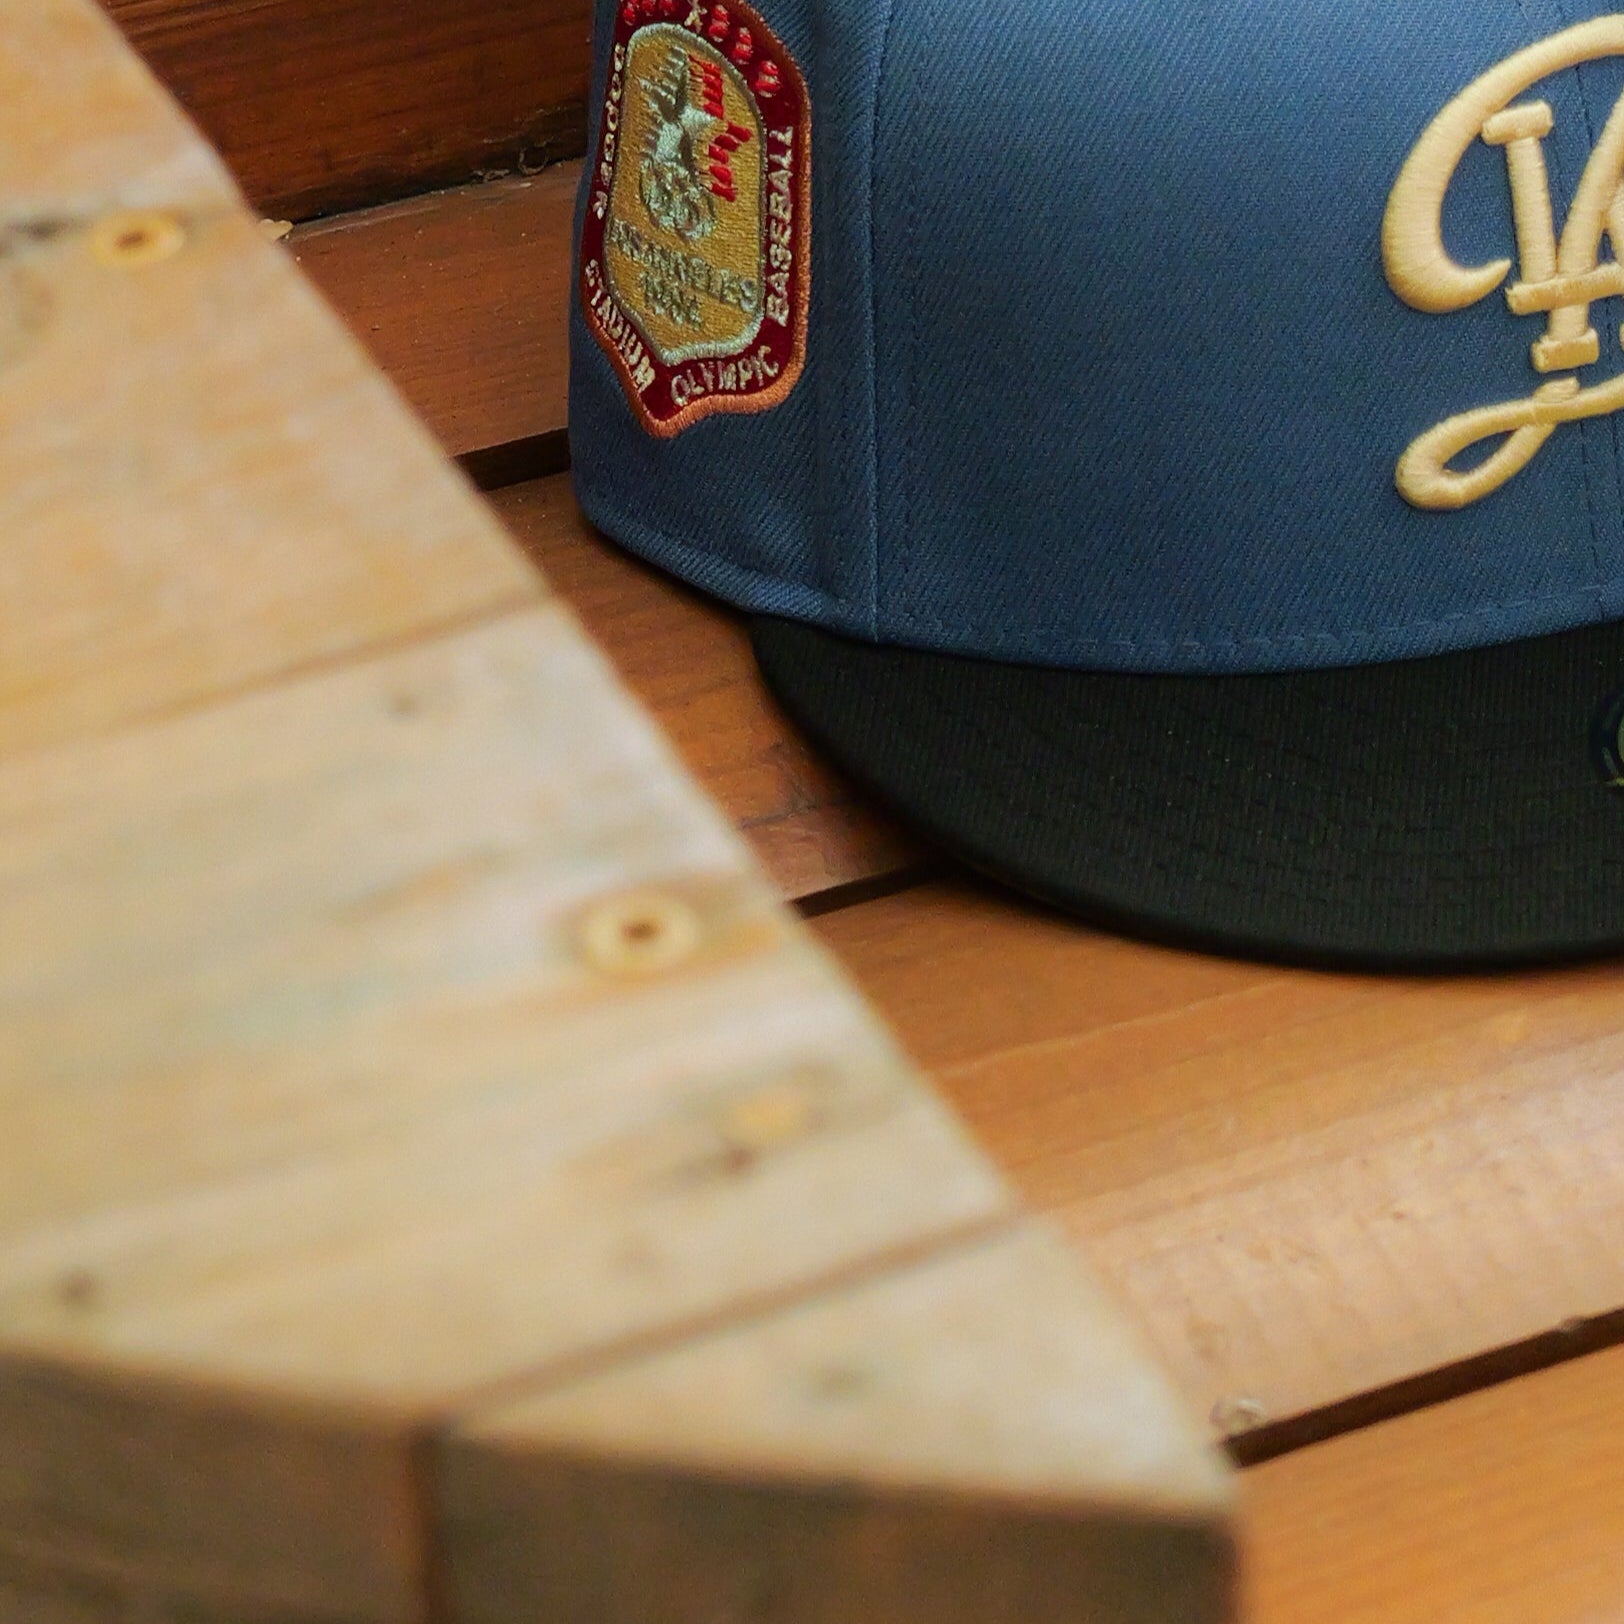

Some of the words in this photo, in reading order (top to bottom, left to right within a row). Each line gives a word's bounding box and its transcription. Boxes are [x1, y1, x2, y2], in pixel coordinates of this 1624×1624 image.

[766, 126, 795, 327] BASEBALL
[585, 259, 656, 393] STADIUM
[670, 344, 780, 407] OLYMPIC
